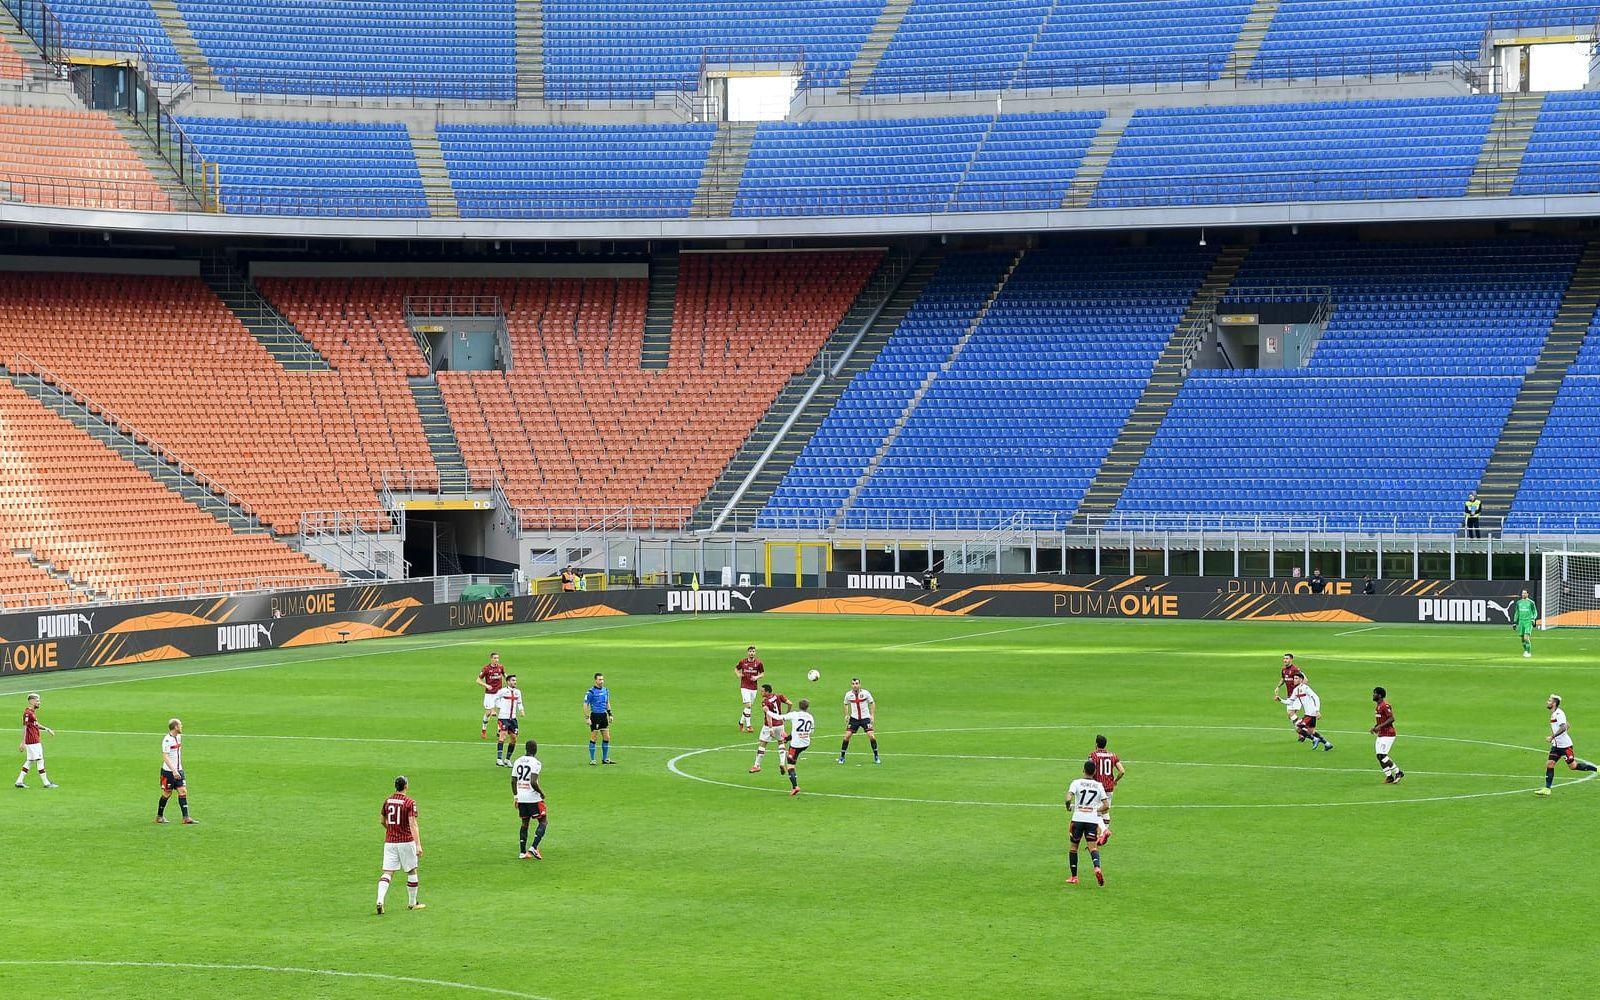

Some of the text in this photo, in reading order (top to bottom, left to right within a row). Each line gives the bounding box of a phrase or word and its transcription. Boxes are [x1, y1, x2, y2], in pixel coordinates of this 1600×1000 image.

[668, 590, 731, 611] PUMA
[1054, 593, 1179, 616] PUMAONE
[1418, 599, 1487, 622] PUMA
[450, 601, 514, 626] PUMAONE
[38, 613, 79, 639] PUMA
[217, 623, 258, 651] PUMA
[796, 718, 812, 732] 20
[516, 764, 531, 781] 92
[1099, 759, 1111, 775] 10
[1080, 789, 1097, 806] 17
[388, 805, 400, 825] 21
